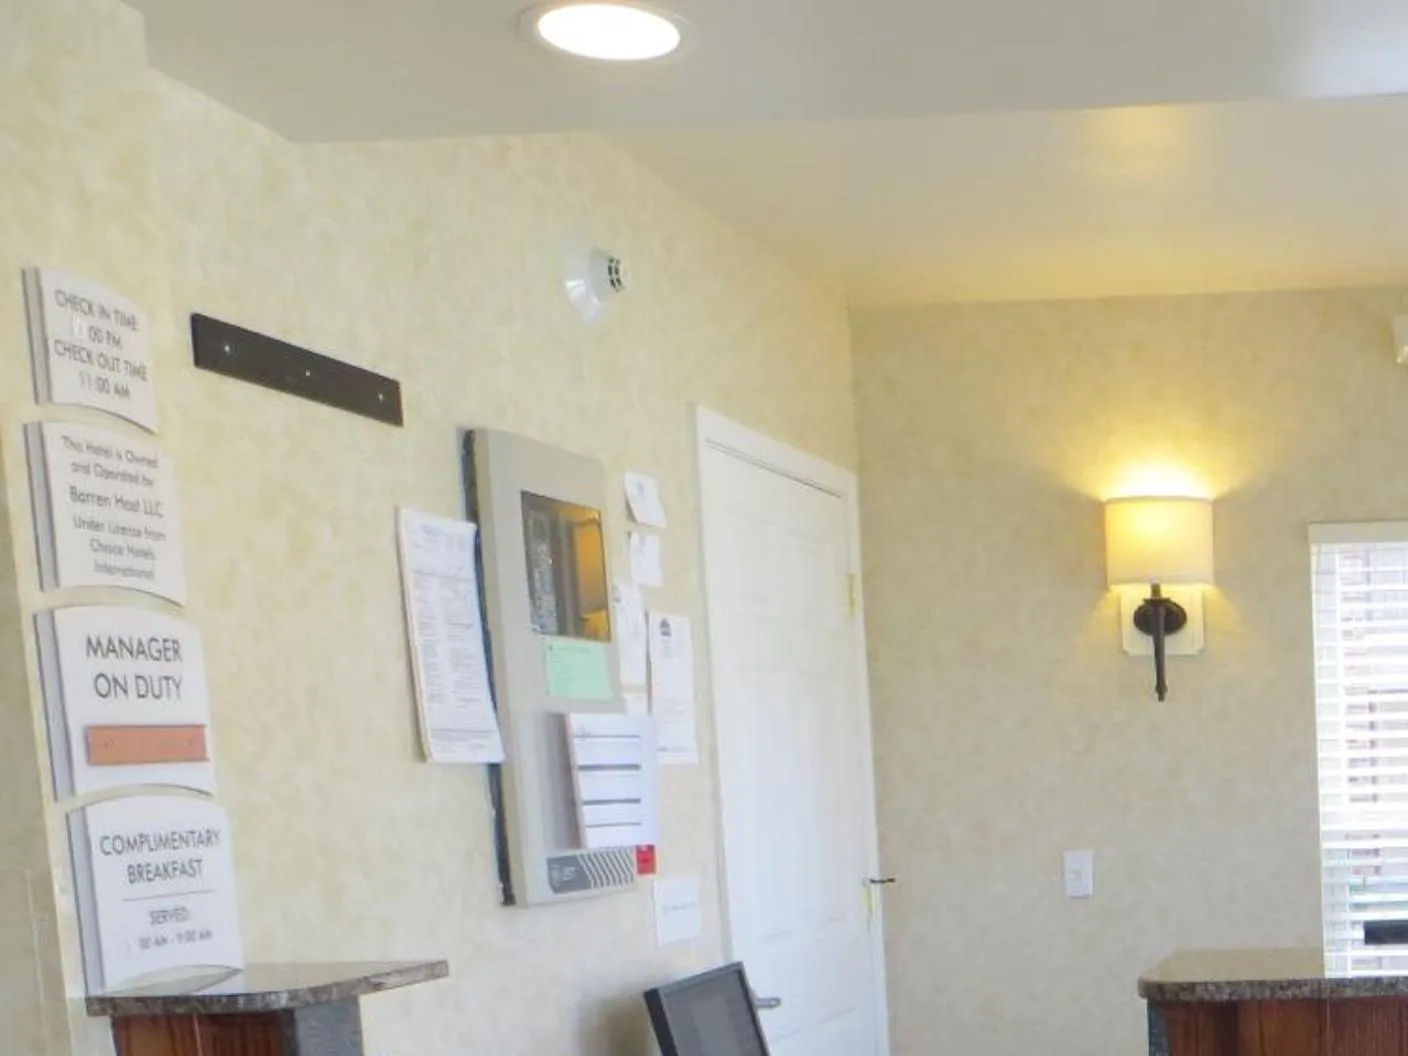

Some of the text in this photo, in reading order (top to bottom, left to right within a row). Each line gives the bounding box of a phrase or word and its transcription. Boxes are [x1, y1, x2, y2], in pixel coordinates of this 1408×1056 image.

[54, 339, 94, 366] CHECK
[97, 351, 120, 373] OUT
[85, 633, 183, 664] MANAGER
[93, 672, 182, 700] ON DUTY
[99, 828, 222, 857] COMPLIMENTARY
[127, 858, 205, 885] BREAKFAST
